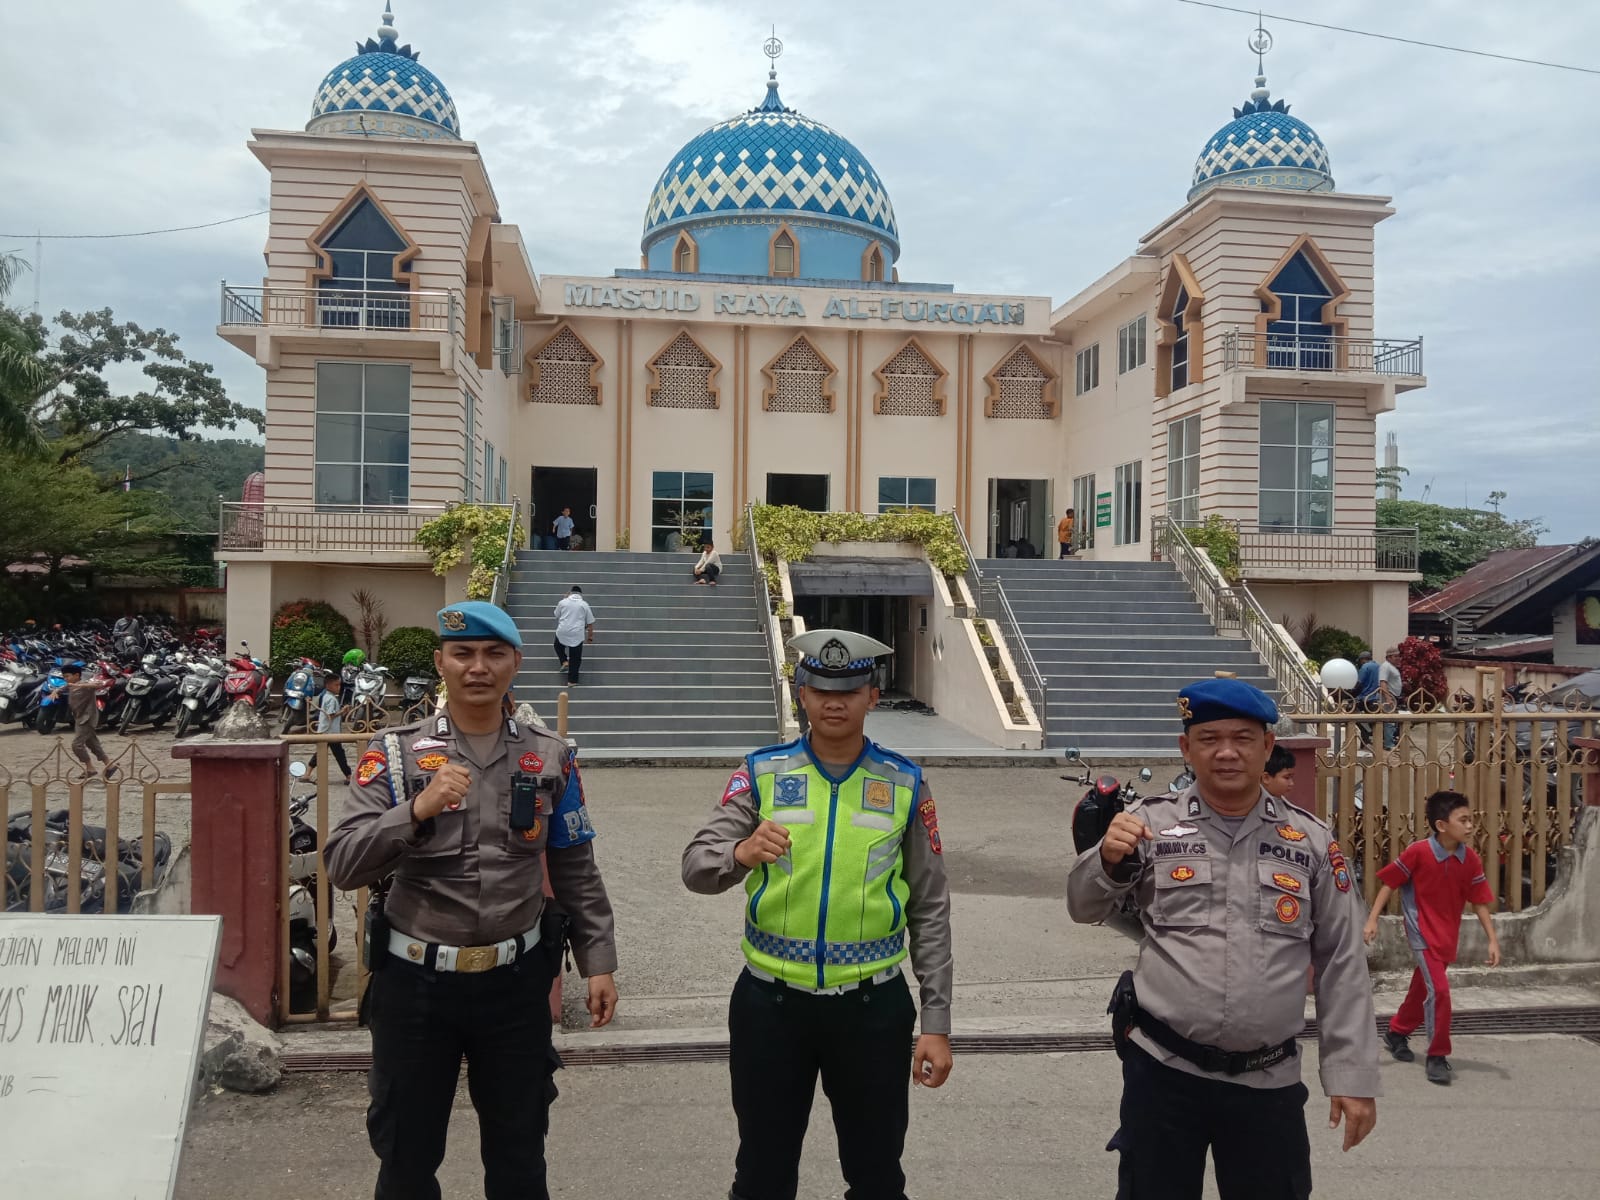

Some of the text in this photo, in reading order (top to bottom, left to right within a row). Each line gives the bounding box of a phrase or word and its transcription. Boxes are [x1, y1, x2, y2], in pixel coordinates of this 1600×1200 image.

[563, 283, 1025, 326] MASJID RAYA AL-FURQAN
[1259, 842, 1310, 868] POLRI
[53, 936, 108, 966] MALAM
[114, 931, 138, 966] INI
